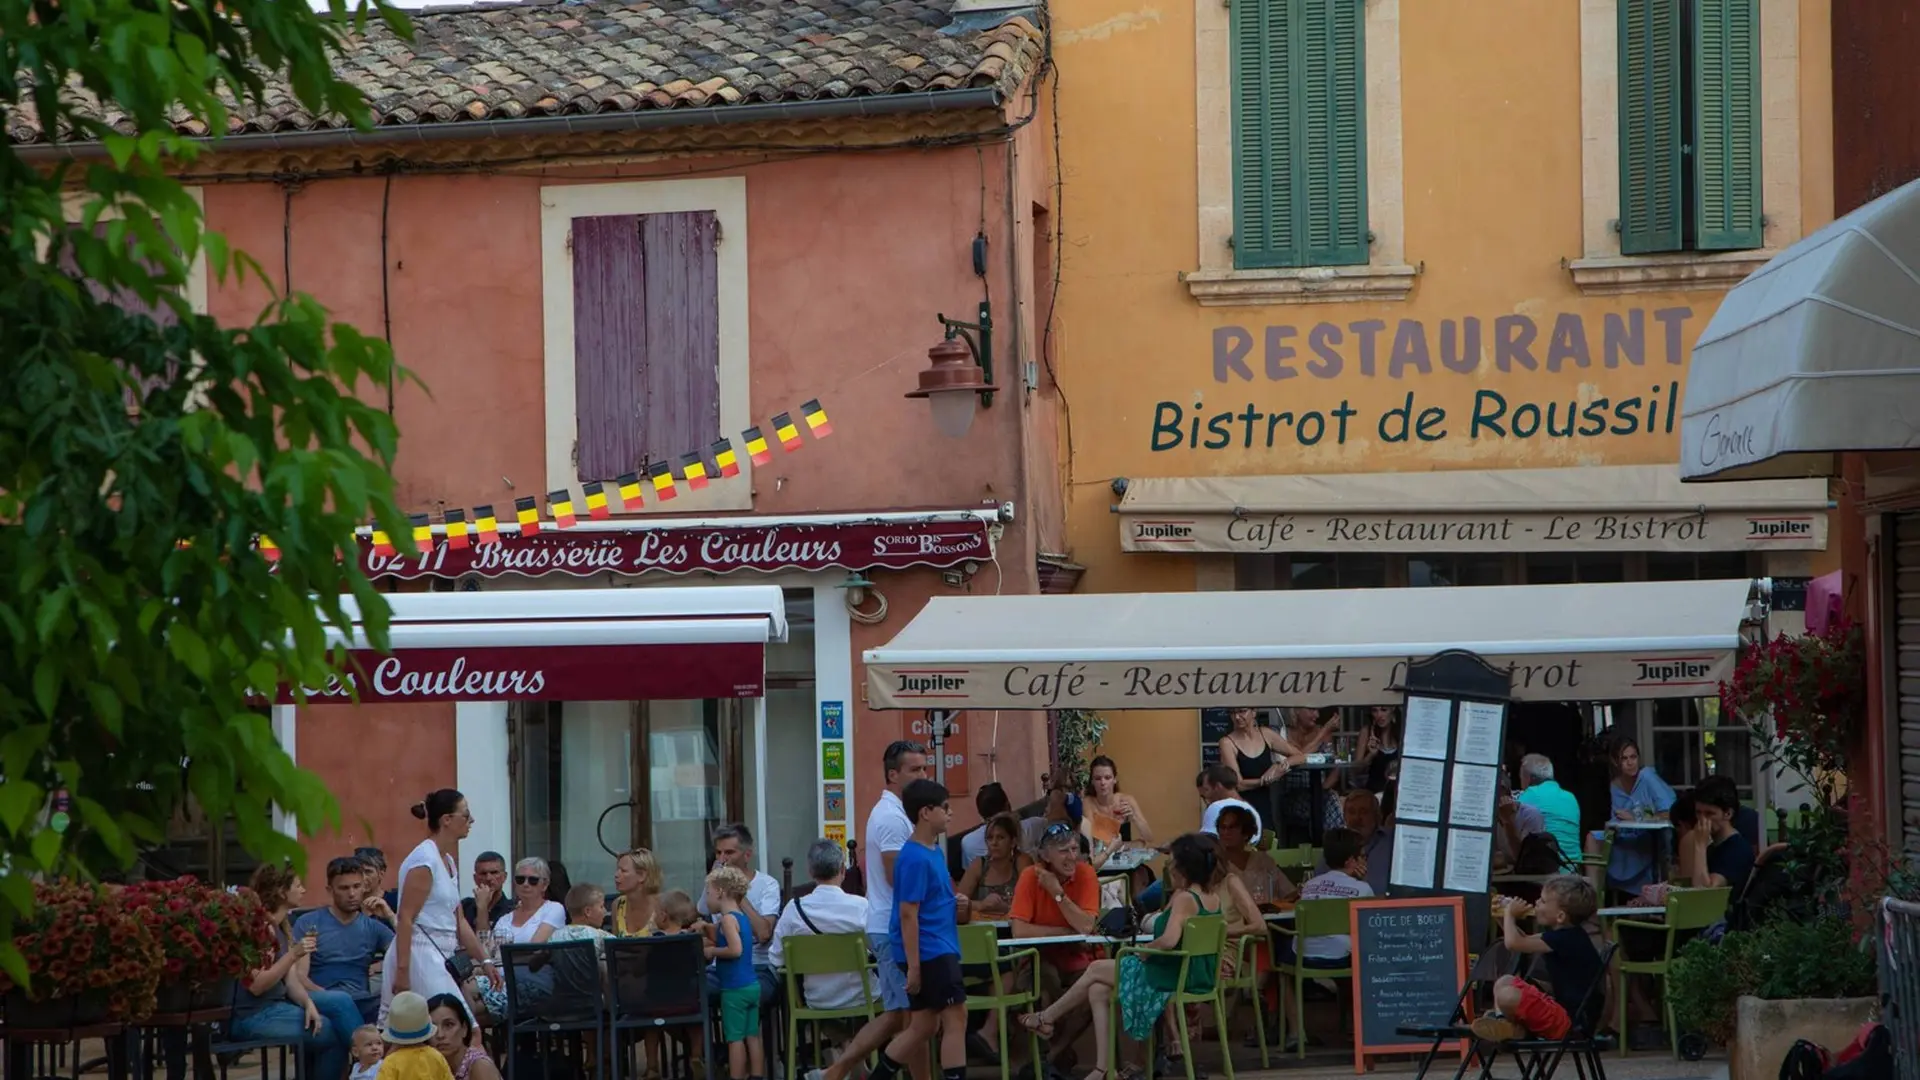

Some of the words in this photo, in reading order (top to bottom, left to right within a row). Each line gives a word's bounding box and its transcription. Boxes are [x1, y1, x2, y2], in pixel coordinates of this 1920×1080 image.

[1211, 304, 1693, 384] RESTAURANT
[1150, 396, 1358, 452] Bistrot
[1378, 391, 1447, 443] de
[1471, 380, 1678, 439] Roussil
[470, 531, 624, 570] Brasserie
[633, 532, 689, 567] Les
[699, 527, 842, 564] Couleurs
[1135, 523, 1192, 540] Jupiler
[1226, 512, 1295, 551] Café
[1326, 513, 1513, 543] Restaurant
[1543, 514, 1584, 542] Le
[1597, 511, 1709, 541] Bistrot
[1749, 520, 1810, 537] Jupiler
[373, 656, 545, 696] Couleurs
[898, 673, 965, 696] Jupiler
[1004, 664, 1087, 711] Café
[1123, 662, 1346, 696] Restaurant
[1383, 662, 1404, 690] L
[1637, 661, 1710, 685] Jupiler
[1368, 913, 1397, 928] CÔTE
[1400, 915, 1412, 926] DE
[1417, 913, 1448, 925] BOEUF
